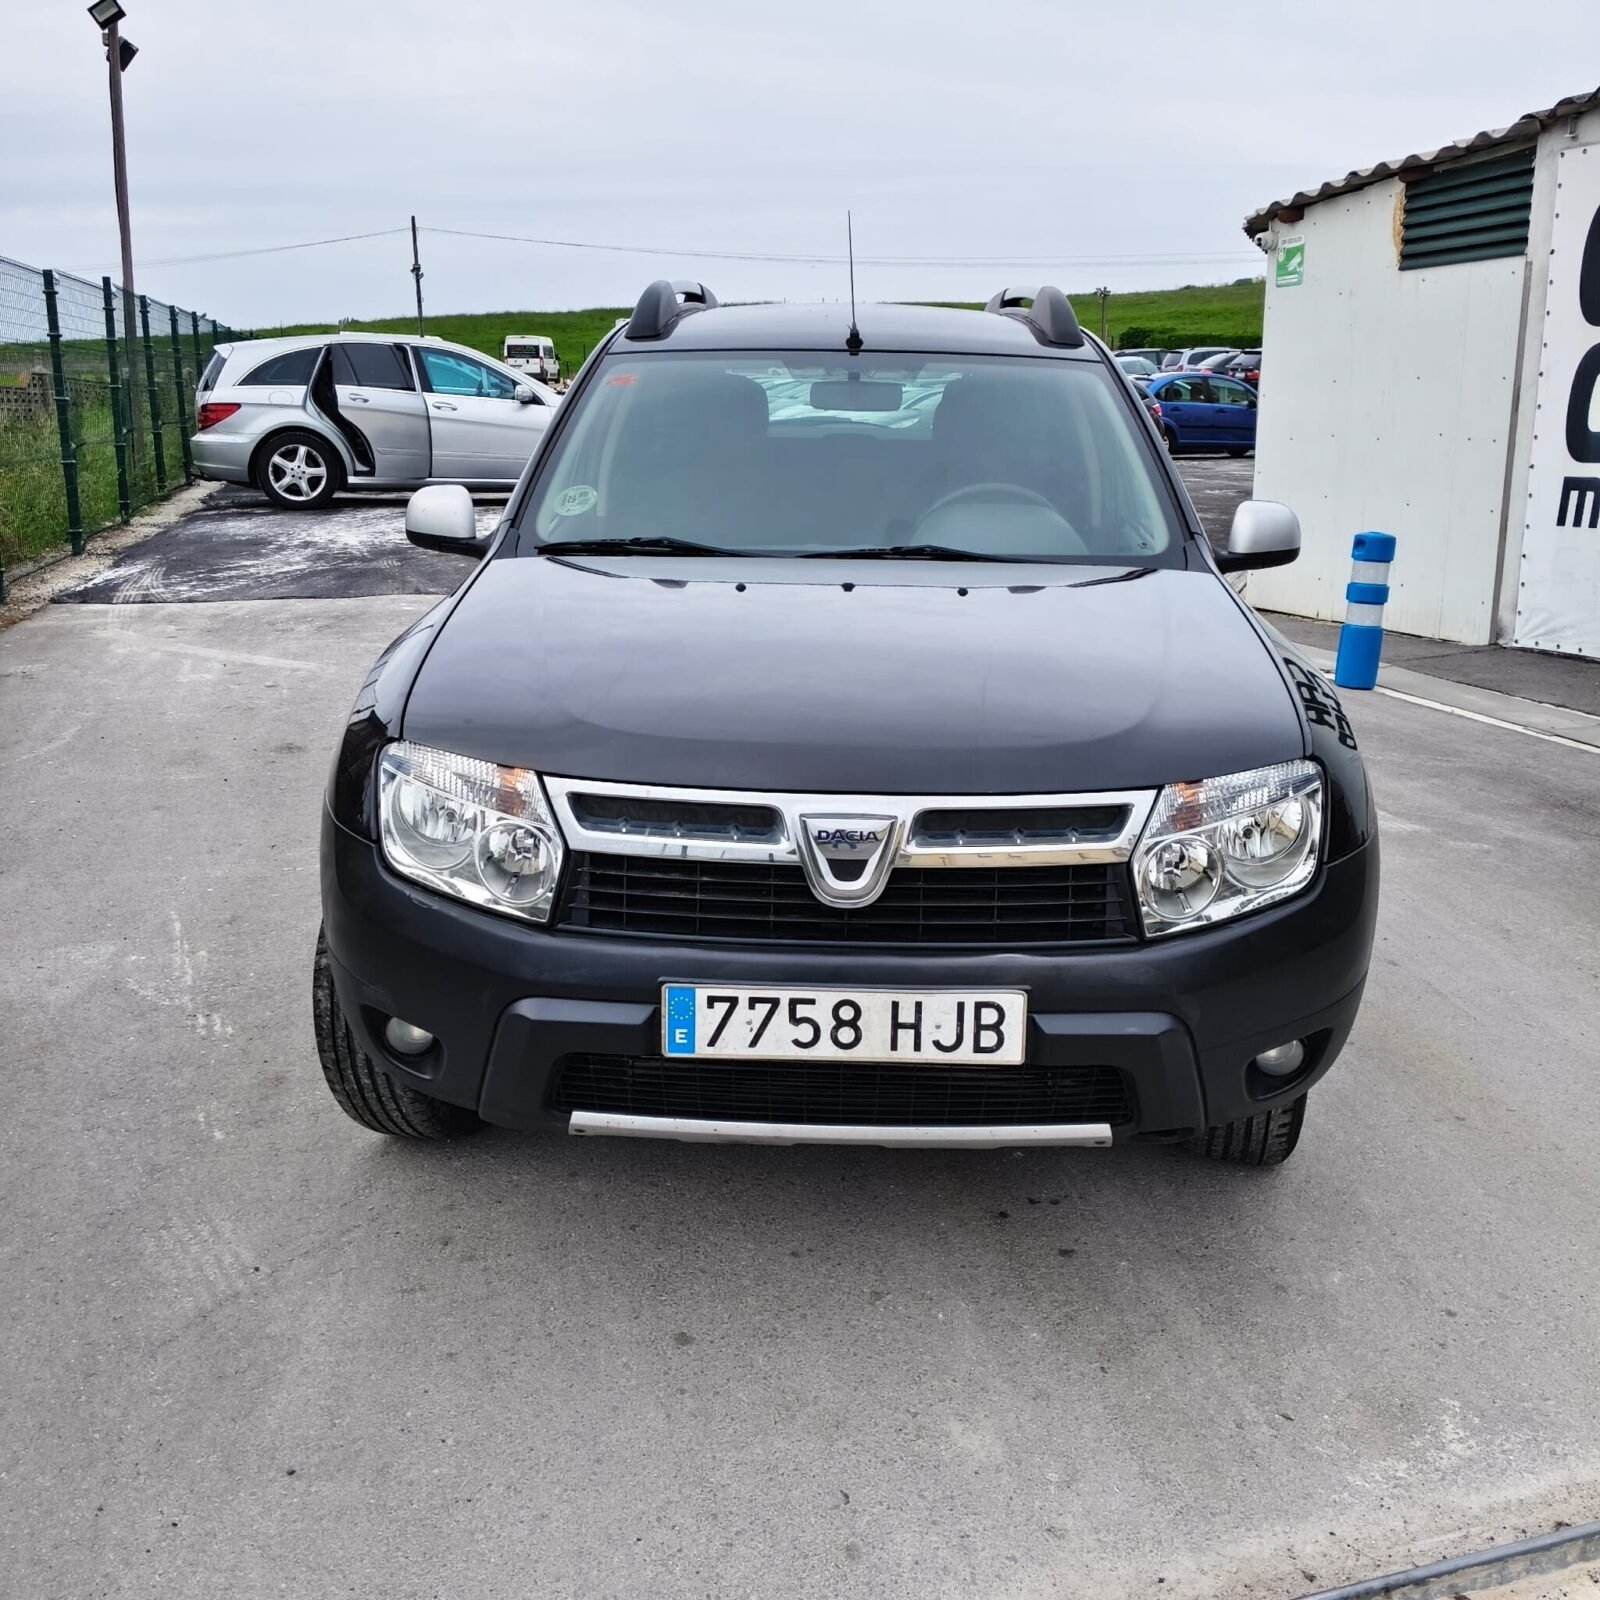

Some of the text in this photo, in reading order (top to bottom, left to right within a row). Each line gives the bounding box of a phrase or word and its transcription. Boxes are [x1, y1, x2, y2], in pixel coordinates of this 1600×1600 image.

[817, 829, 879, 841] DACIA
[707, 995, 1006, 1054] 7758 HJB
[675, 1028, 688, 1043] E
